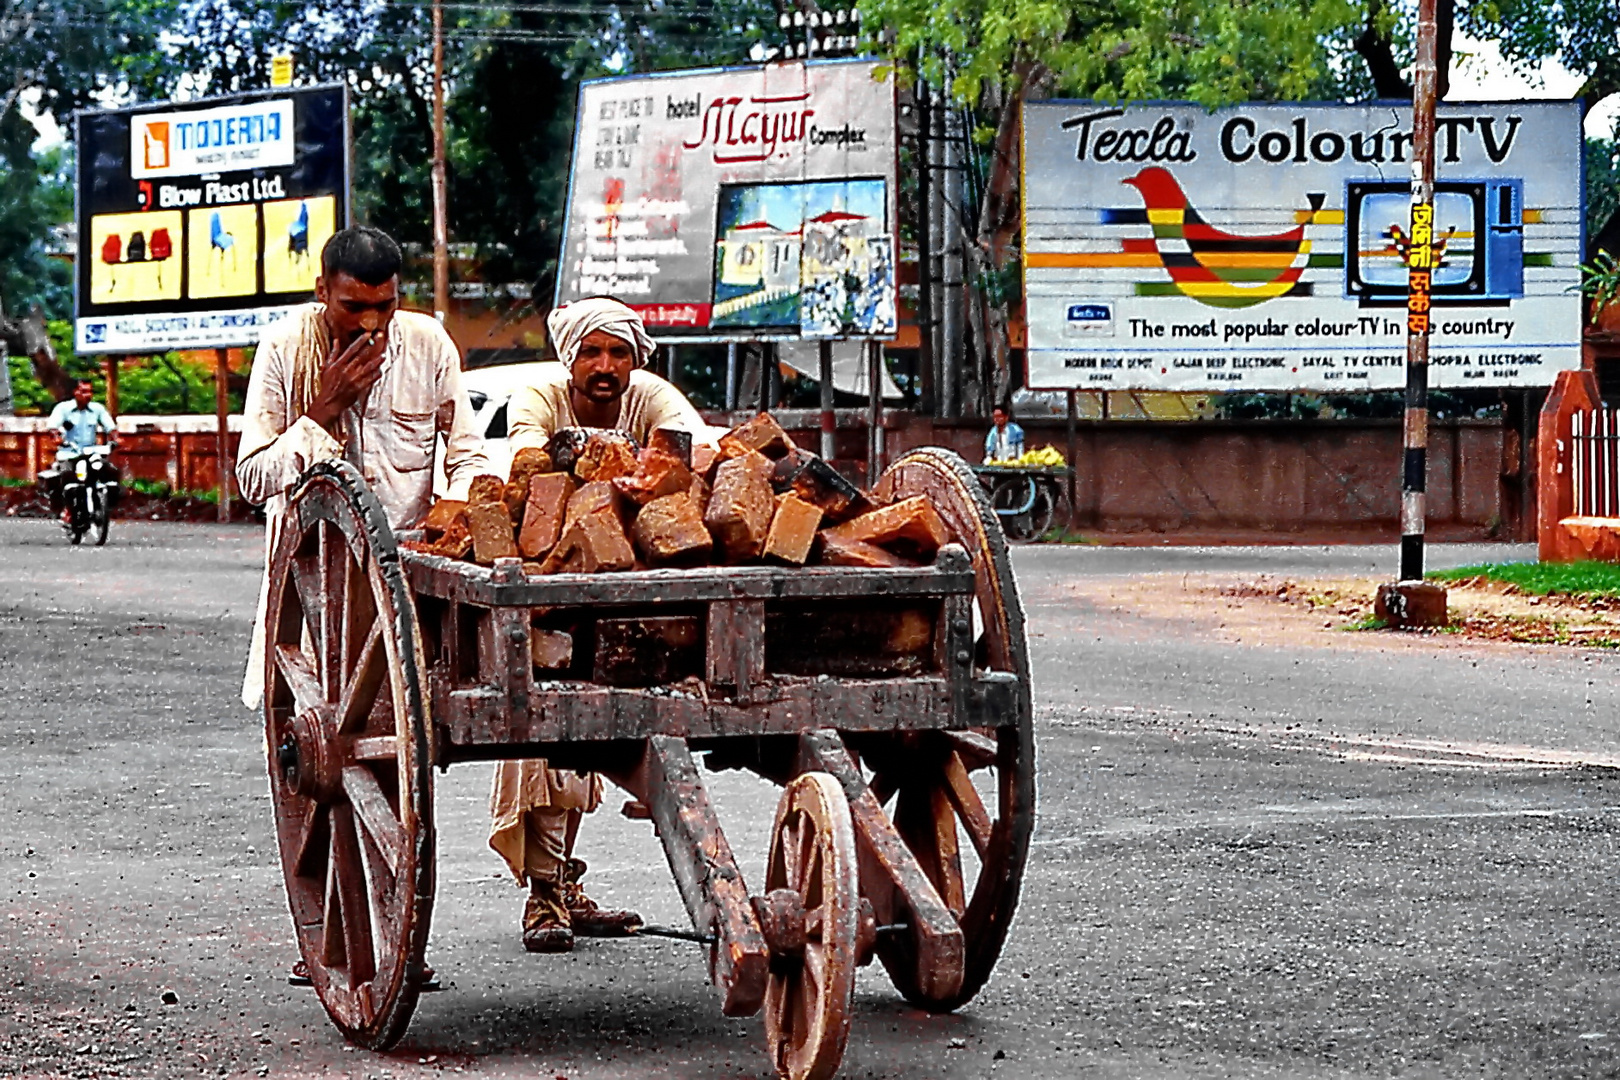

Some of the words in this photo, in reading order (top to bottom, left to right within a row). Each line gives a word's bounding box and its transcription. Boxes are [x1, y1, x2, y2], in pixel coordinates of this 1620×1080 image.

[666, 92, 701, 120] hotel
[683, 94, 815, 163] Mayur
[810, 123, 867, 151] Complex
[1062, 110, 1197, 162] Texla
[1221, 116, 1414, 163] Colour
[1435, 116, 1523, 163] TV
[159, 184, 202, 208] Blow
[205, 181, 250, 204] Plast
[1129, 318, 1164, 337] The
[1171, 318, 1218, 337] most
[1224, 317, 1289, 342] popular
[1383, 318, 1401, 335] in
[1442, 318, 1515, 340] country
[1232, 357, 1286, 369] ELECTRONIC
[1343, 355, 1359, 367] TV
[1362, 355, 1403, 368] CENTRE
[1478, 353, 1543, 367] ELECTRONIC
